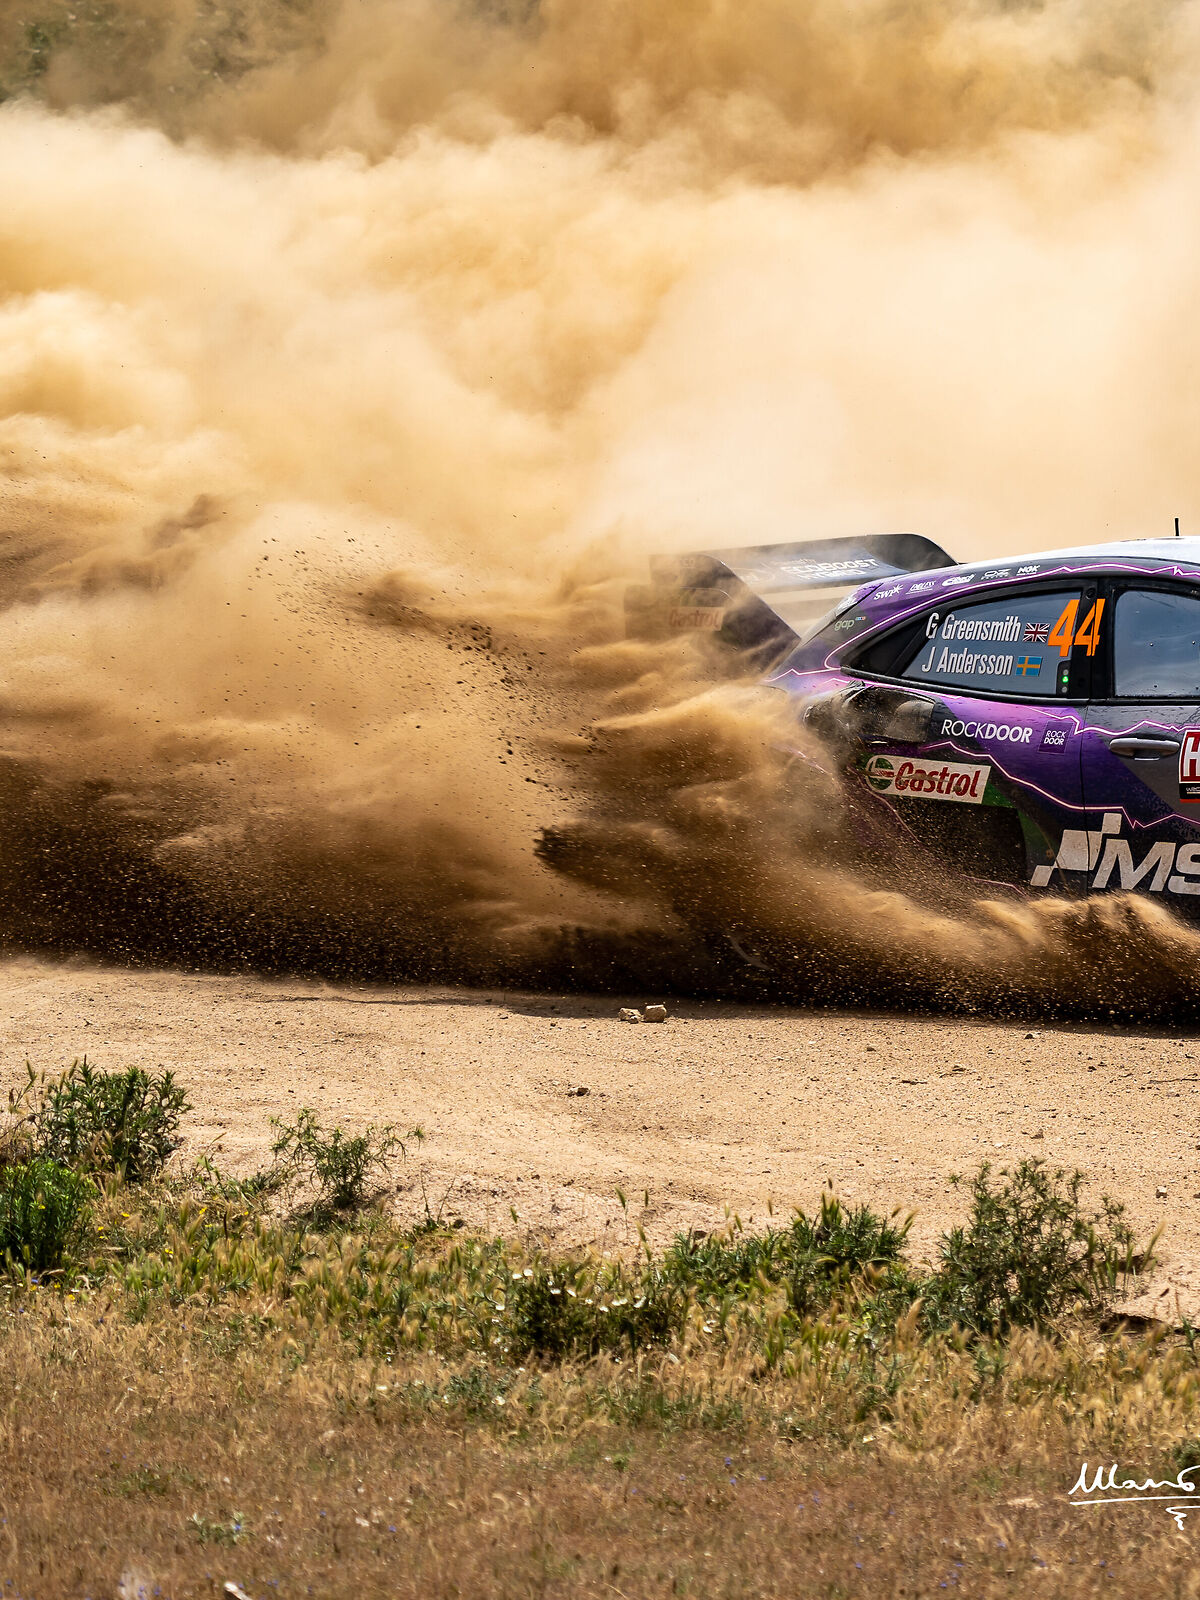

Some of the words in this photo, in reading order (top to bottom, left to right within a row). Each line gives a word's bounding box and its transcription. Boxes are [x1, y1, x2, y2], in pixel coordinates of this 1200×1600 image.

[925, 612, 940, 639] G
[941, 613, 1021, 642] Greensmith
[1047, 598, 1106, 657] 44
[921, 646, 936, 673] J
[936, 647, 1014, 676] Andersson
[941, 719, 1033, 743] ROCKDOOR
[1043, 736, 1066, 746] DOOR
[1045, 730, 1067, 738] ROCK
[895, 762, 981, 797] Castrol
